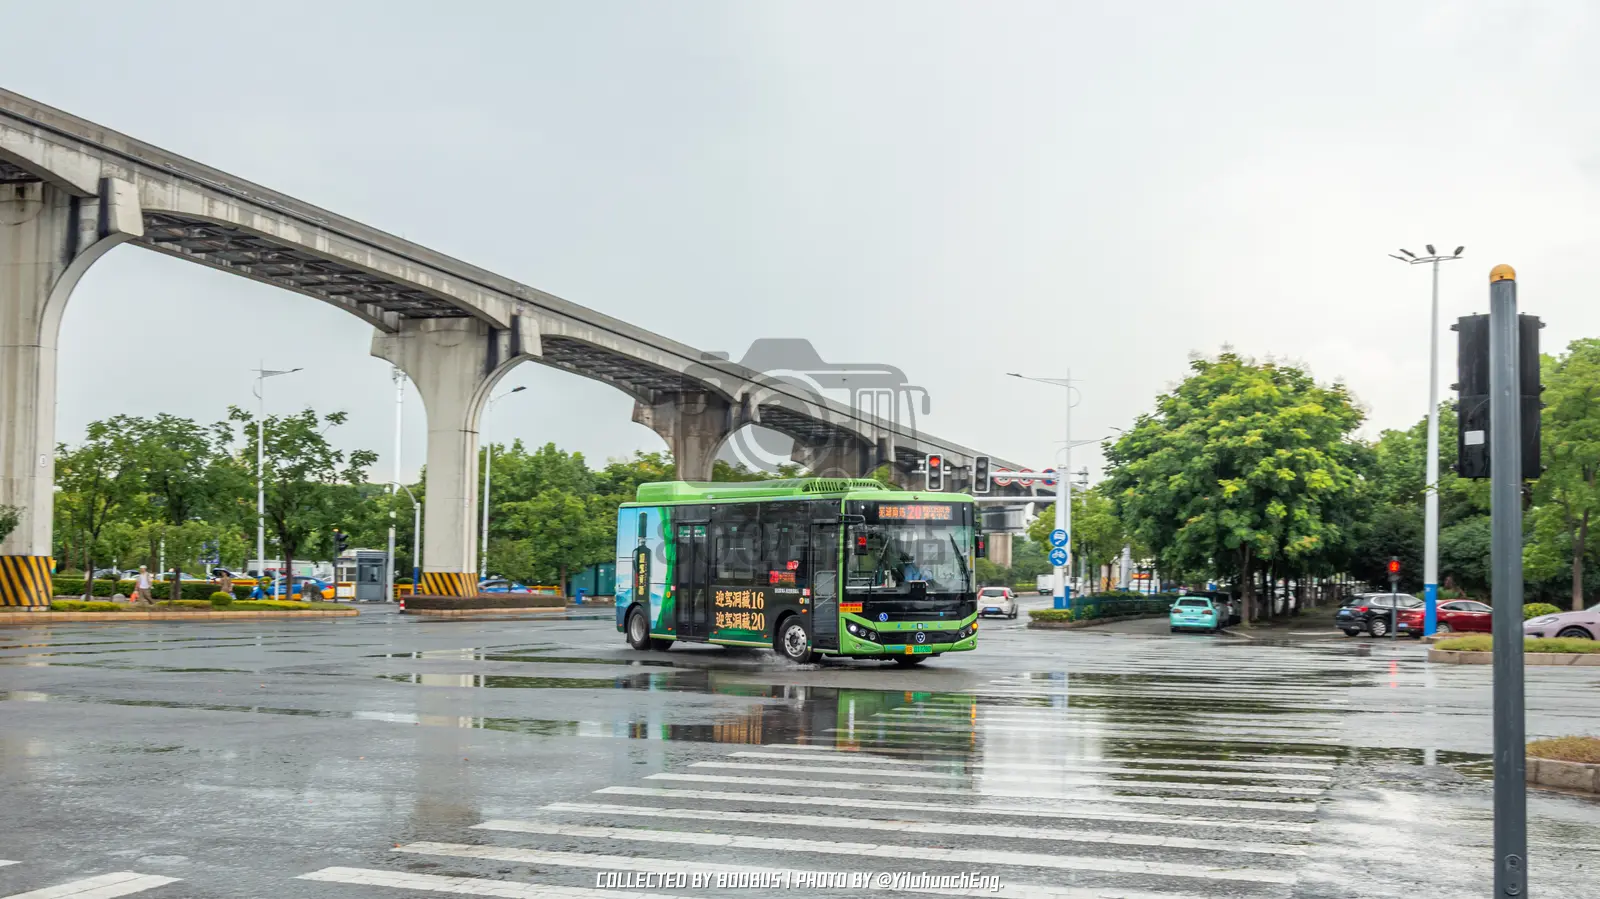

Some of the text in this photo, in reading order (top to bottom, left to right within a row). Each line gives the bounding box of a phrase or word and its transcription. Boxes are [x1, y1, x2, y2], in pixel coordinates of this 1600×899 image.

[907, 504, 921, 519] 20
[715, 611, 765, 631] 迎驾洞藏20
